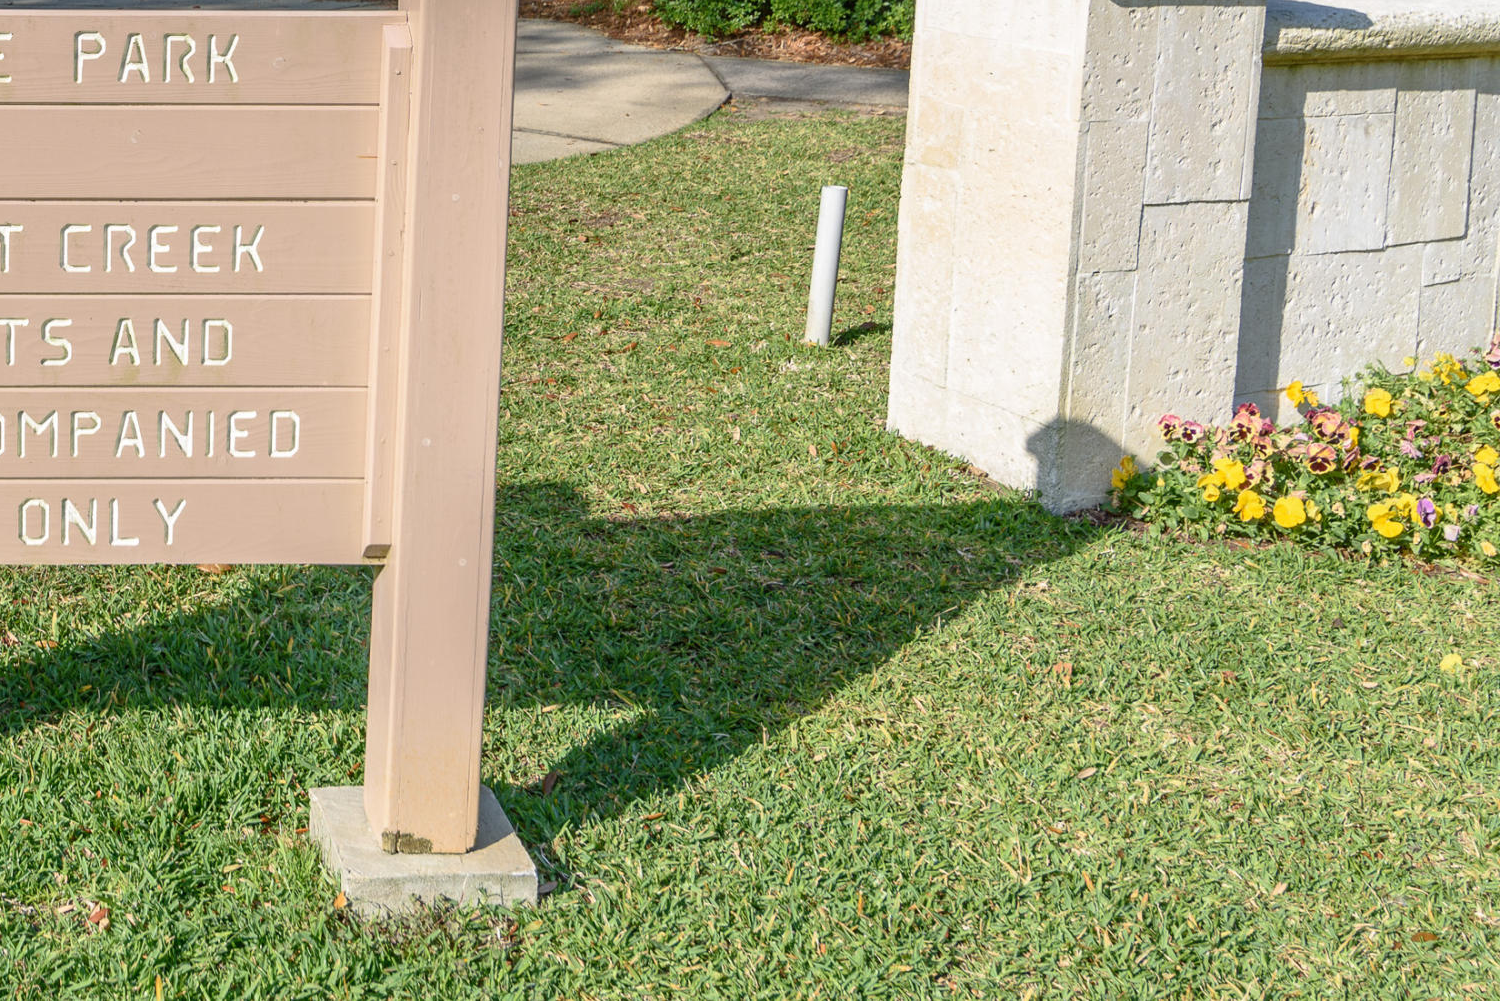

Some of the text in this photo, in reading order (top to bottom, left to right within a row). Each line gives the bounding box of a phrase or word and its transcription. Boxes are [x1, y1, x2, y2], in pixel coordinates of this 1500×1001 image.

[72, 30, 241, 84] PARK
[58, 223, 266, 274] CREEK
[109, 318, 235, 368] AND
[18, 497, 189, 548] ONLY
